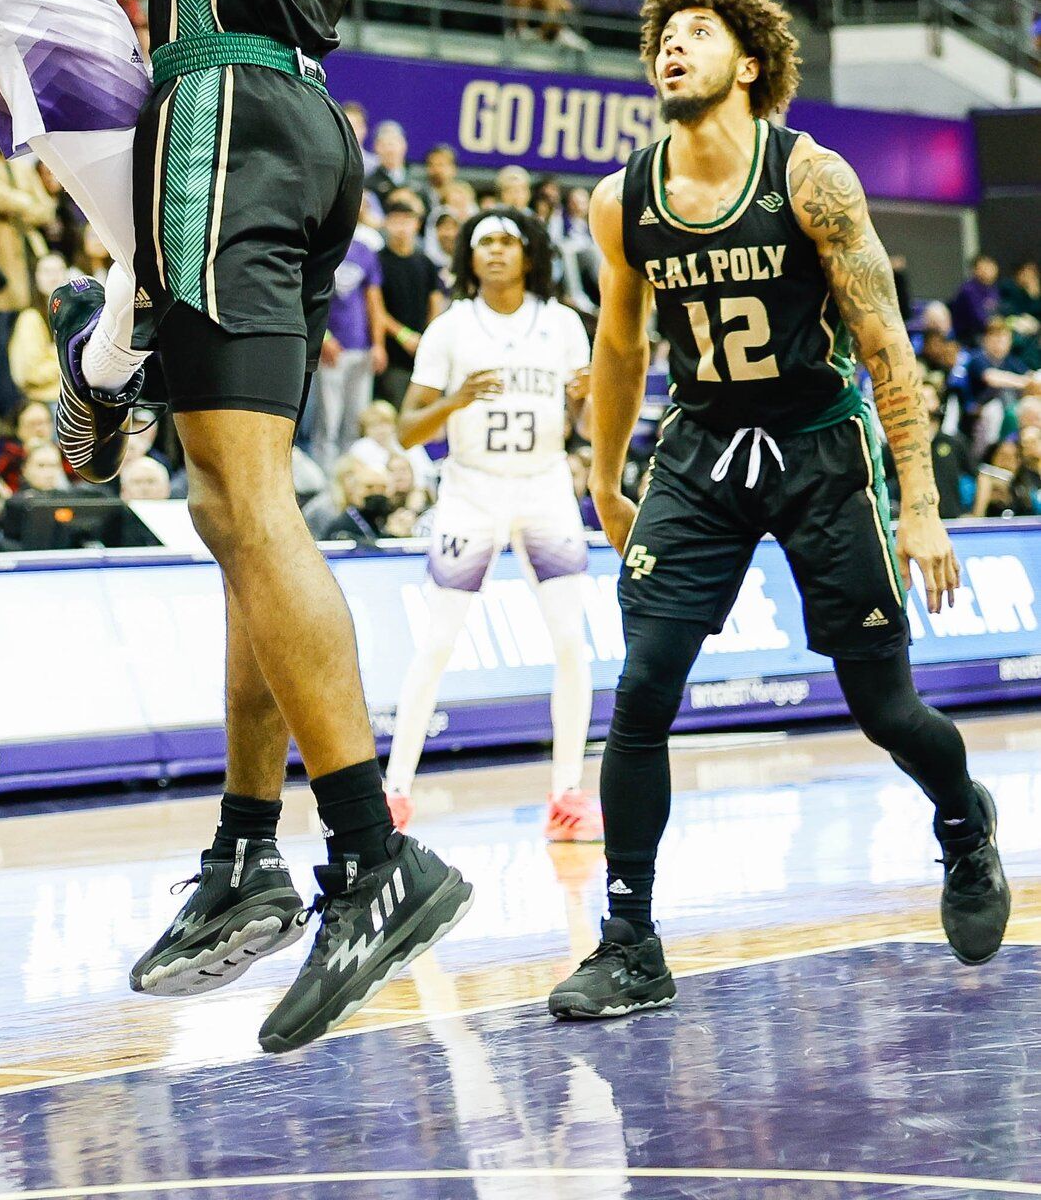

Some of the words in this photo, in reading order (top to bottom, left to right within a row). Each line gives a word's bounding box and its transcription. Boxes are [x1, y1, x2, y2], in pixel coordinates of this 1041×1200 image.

[459, 79, 535, 156] GO
[537, 87, 657, 165] HUS
[644, 252, 708, 290] CAL
[710, 244, 787, 283] POLY
[681, 296, 780, 383] 12
[487, 411, 535, 452] 23
[441, 533, 469, 558] W
